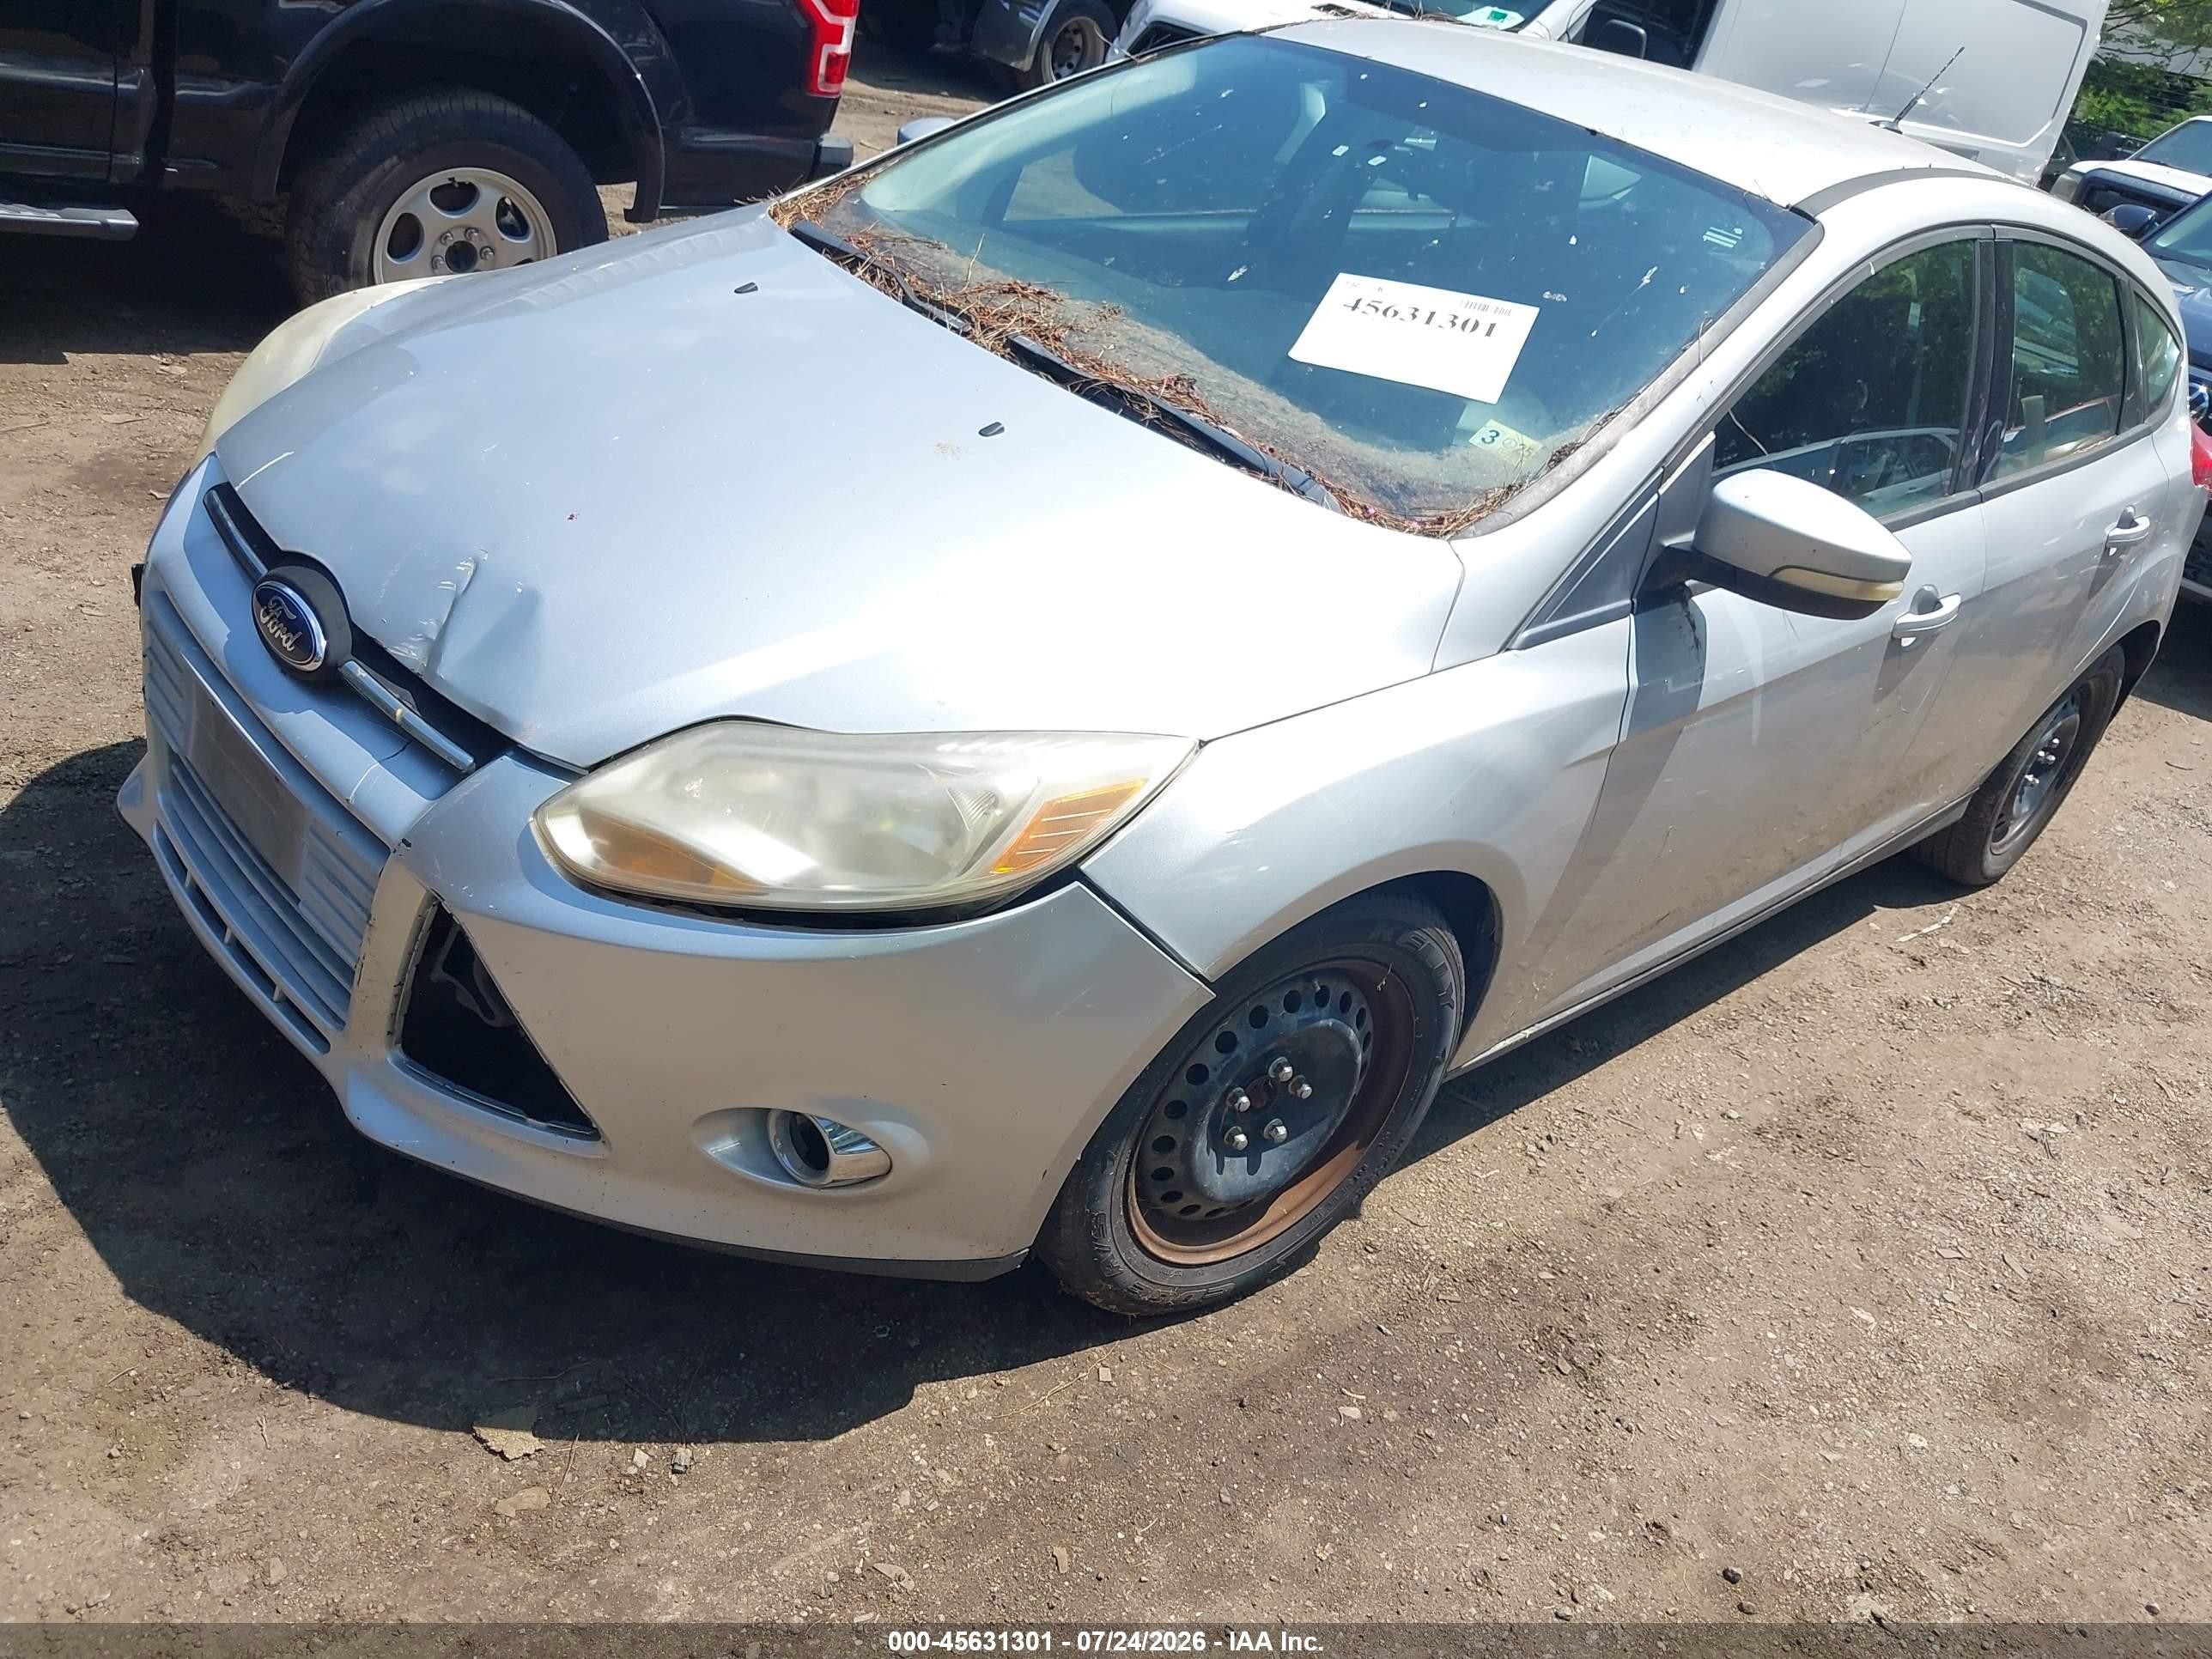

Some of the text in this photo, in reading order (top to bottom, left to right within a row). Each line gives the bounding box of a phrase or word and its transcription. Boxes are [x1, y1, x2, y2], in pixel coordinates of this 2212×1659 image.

[1343, 297, 1498, 337] 45631301
[1481, 429, 1500, 444] 3
[259, 595, 303, 652] Ford
